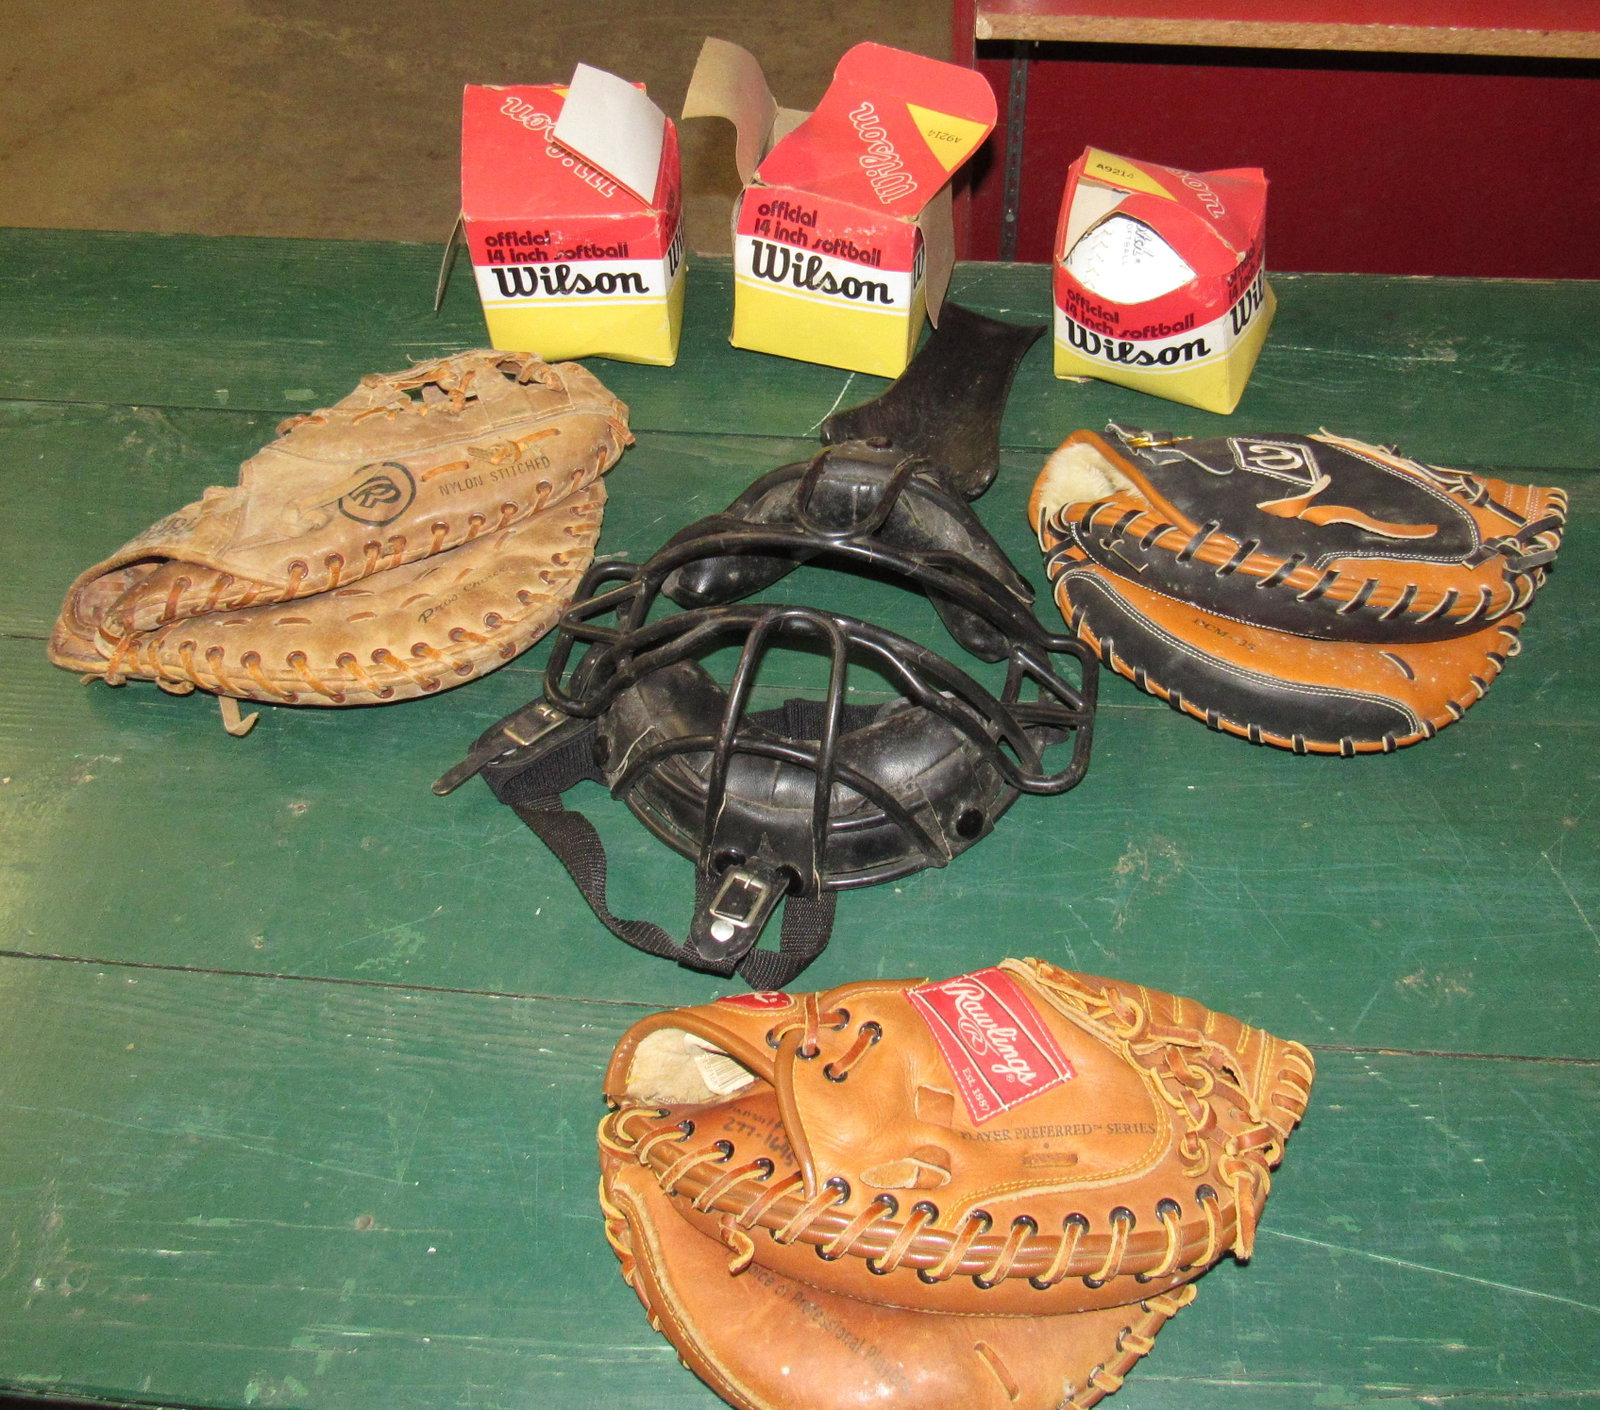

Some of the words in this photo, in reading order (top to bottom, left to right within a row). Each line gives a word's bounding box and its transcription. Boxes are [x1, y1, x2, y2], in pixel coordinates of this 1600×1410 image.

[849, 101, 918, 206] Wilson
[927, 127, 962, 145] A9214
[1096, 163, 1135, 180] A9214
[757, 200, 818, 228] official
[485, 230, 551, 248] official
[487, 249, 504, 264] 14
[510, 248, 548, 263] inch
[554, 242, 629, 260] softball
[754, 218, 771, 235] 14
[774, 223, 809, 247] inch
[812, 237, 882, 268] softball
[491, 264, 650, 298] Wilson
[751, 240, 895, 305] Wilson
[1065, 301, 1078, 319] 14
[1079, 312, 1114, 337] inch
[1119, 314, 1195, 340] softball
[1066, 288, 1120, 325] official
[1065, 316, 1211, 367] Wilson
[438, 475, 484, 496] NYLON
[490, 456, 551, 482] STITCHED
[940, 981, 1037, 1087] Rawlings
[972, 1087, 991, 1112] 1887
[960, 1129, 1012, 1143] PLAYER
[1106, 1122, 1157, 1135] SERIES
